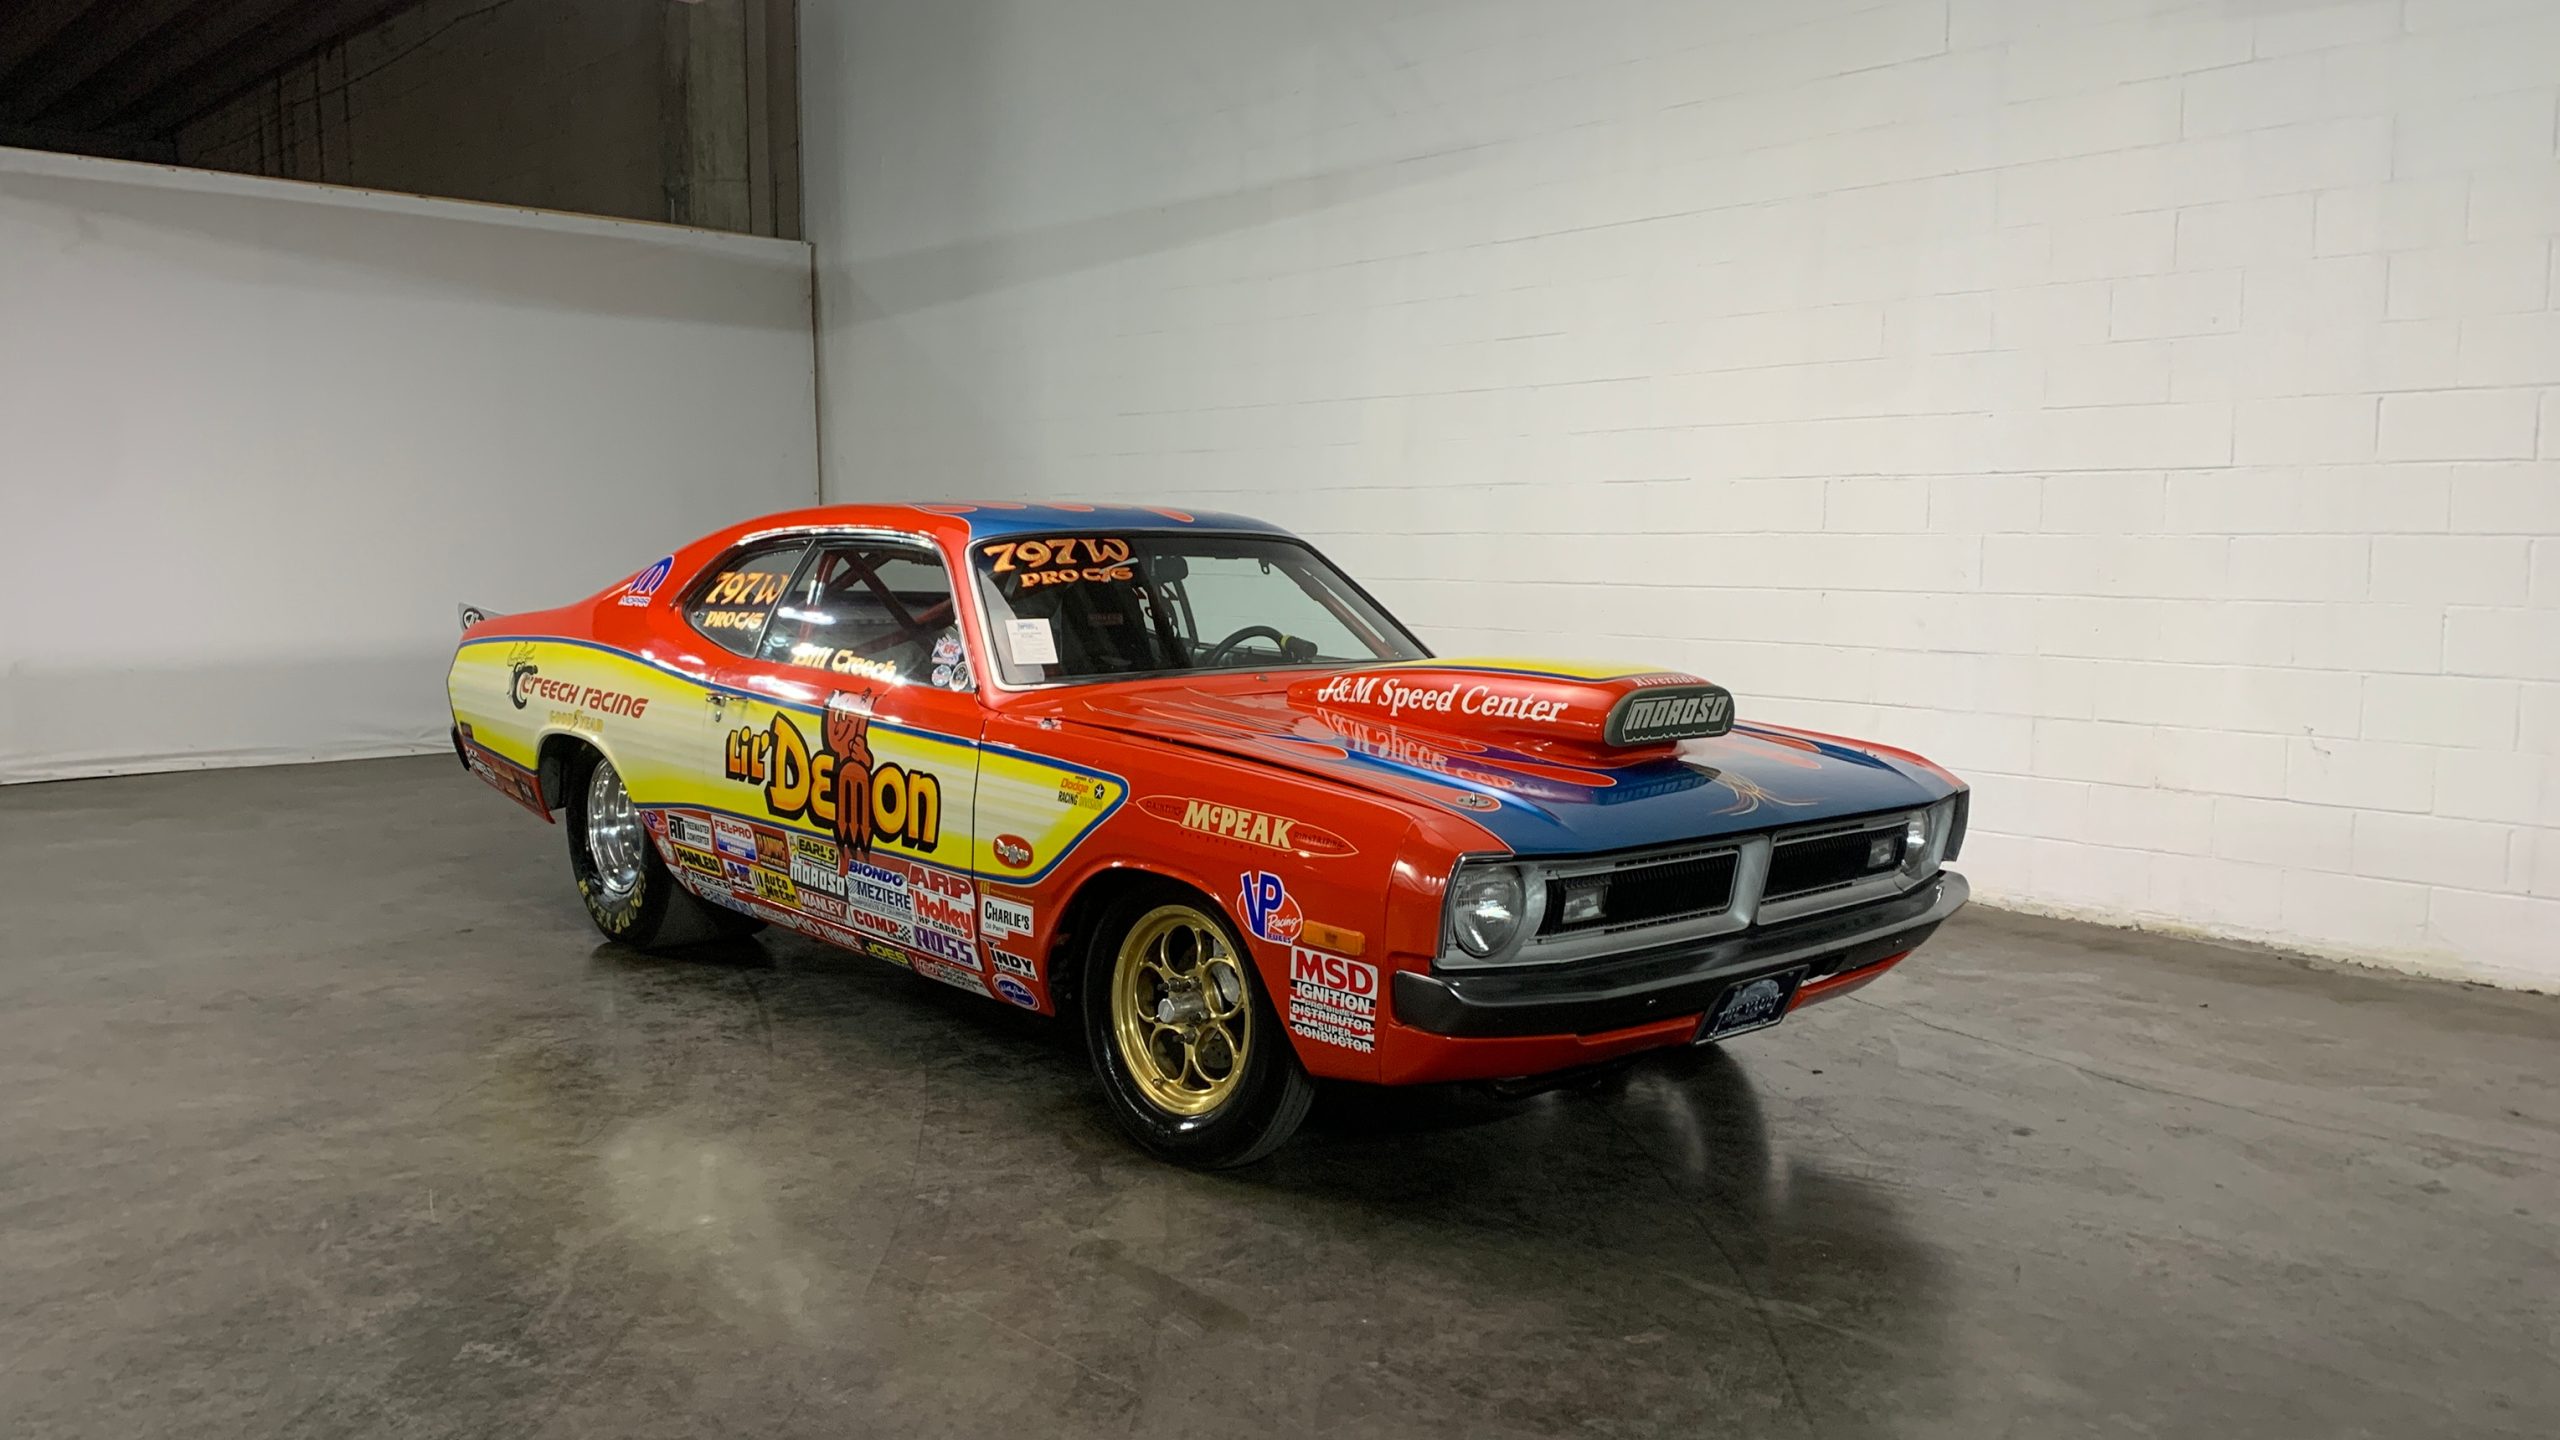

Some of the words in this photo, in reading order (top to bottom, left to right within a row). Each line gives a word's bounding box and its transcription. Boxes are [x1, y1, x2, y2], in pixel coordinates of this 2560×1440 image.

[983, 538, 1129, 573] 797W
[705, 571, 790, 606] 797W
[1020, 569, 1079, 588] PRO
[703, 611, 736, 629] PRO
[832, 649, 899, 682] Creech
[1317, 676, 1380, 704] J&M
[1377, 678, 1462, 717] Speed
[1461, 685, 1569, 722] Center
[1625, 696, 1729, 731] MOROSO
[1057, 791, 1079, 806] RACING
[1060, 778, 1089, 795] Dodge
[714, 820, 752, 839] FEL-PRO
[799, 839, 836, 861] EARL'S
[765, 872, 788, 889] Auto
[790, 862, 846, 897] MOROSO
[849, 860, 904, 887] BIONDO
[909, 866, 972, 900] ARP
[765, 885, 796, 903] Meter
[798, 890, 841, 917] MANLEY
[857, 881, 912, 910] MEZIERE
[1241, 871, 1284, 939] VP
[853, 909, 899, 934] COMP
[915, 891, 974, 940] Holley
[932, 919, 964, 938] CARBS
[985, 901, 1030, 931] CHARLIE'S
[1267, 914, 1301, 934] Racing
[914, 926, 974, 965] ROSS
[1267, 933, 1293, 944] FUELS
[866, 943, 909, 965] JOES
[992, 950, 1032, 972] INDY
[1295, 951, 1374, 996] MSD
[1296, 982, 1370, 1014] IGNITION
[1292, 1003, 1371, 1033] DISTRIBUTOR
[1317, 1022, 1352, 1039] SUPER
[1294, 1024, 1372, 1054] CONDUCTOR
